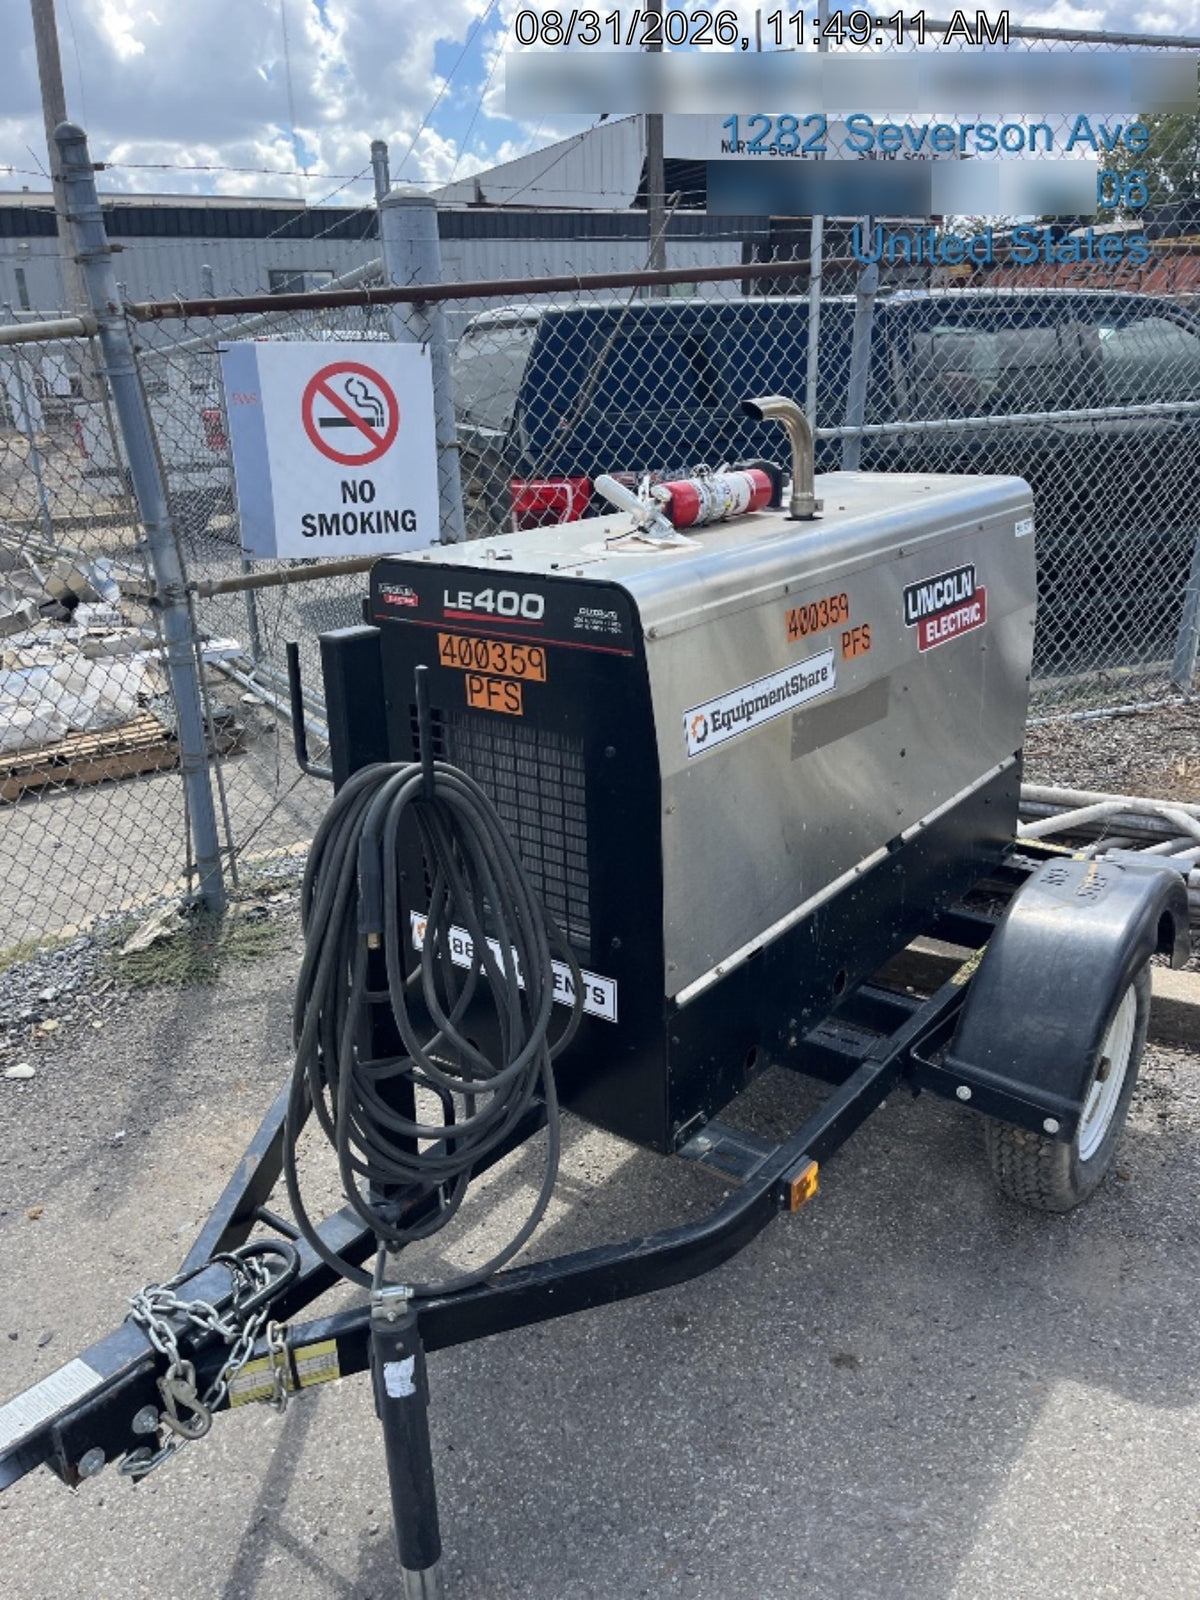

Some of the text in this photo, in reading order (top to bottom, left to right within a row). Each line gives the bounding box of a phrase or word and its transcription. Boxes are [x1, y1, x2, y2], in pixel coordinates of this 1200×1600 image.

[340, 480, 376, 504] NO
[301, 509, 417, 538] SMOKING
[443, 588, 545, 620] LE400
[906, 569, 973, 617] LINCOLN
[787, 593, 849, 637] 400359
[926, 602, 981, 642] ELECTRIC
[441, 636, 545, 680] 400359
[841, 624, 872, 656] PFS
[468, 676, 521, 712] PFS
[710, 663, 829, 733] EquipmentShare
